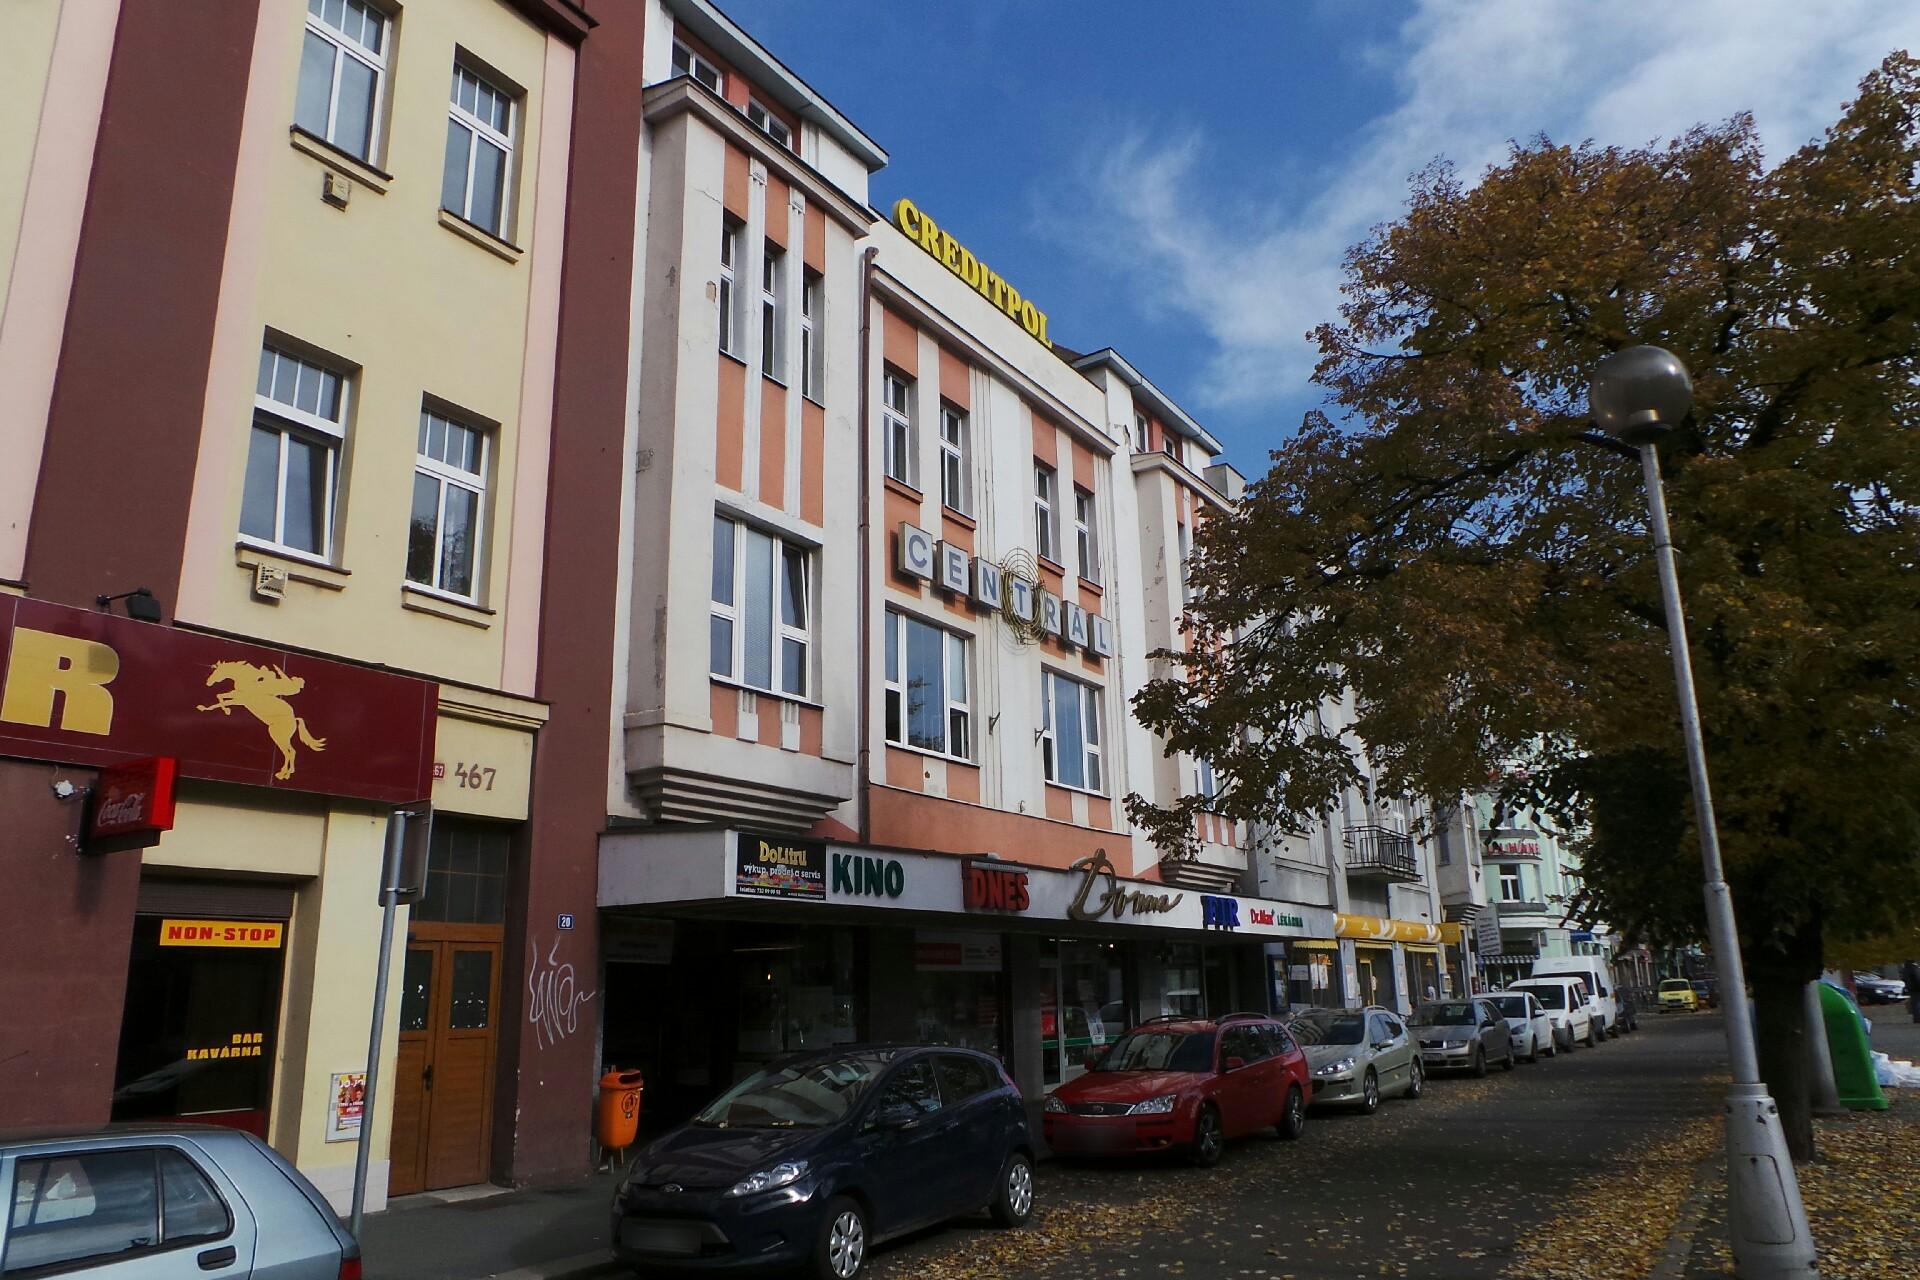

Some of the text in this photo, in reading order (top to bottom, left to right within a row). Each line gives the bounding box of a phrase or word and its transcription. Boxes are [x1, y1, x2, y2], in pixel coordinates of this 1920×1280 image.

[893, 198, 1053, 349] CREDITPOL
[1, 626, 120, 736] R
[455, 762, 496, 791] 467
[832, 853, 905, 899] KINO
[964, 867, 1030, 912] DNES
[168, 926, 276, 941] NON-STOP
[561, 916, 571, 928] 20
[186, 1046, 262, 1060] KAVÁRNA
[232, 1033, 263, 1044] BAR
